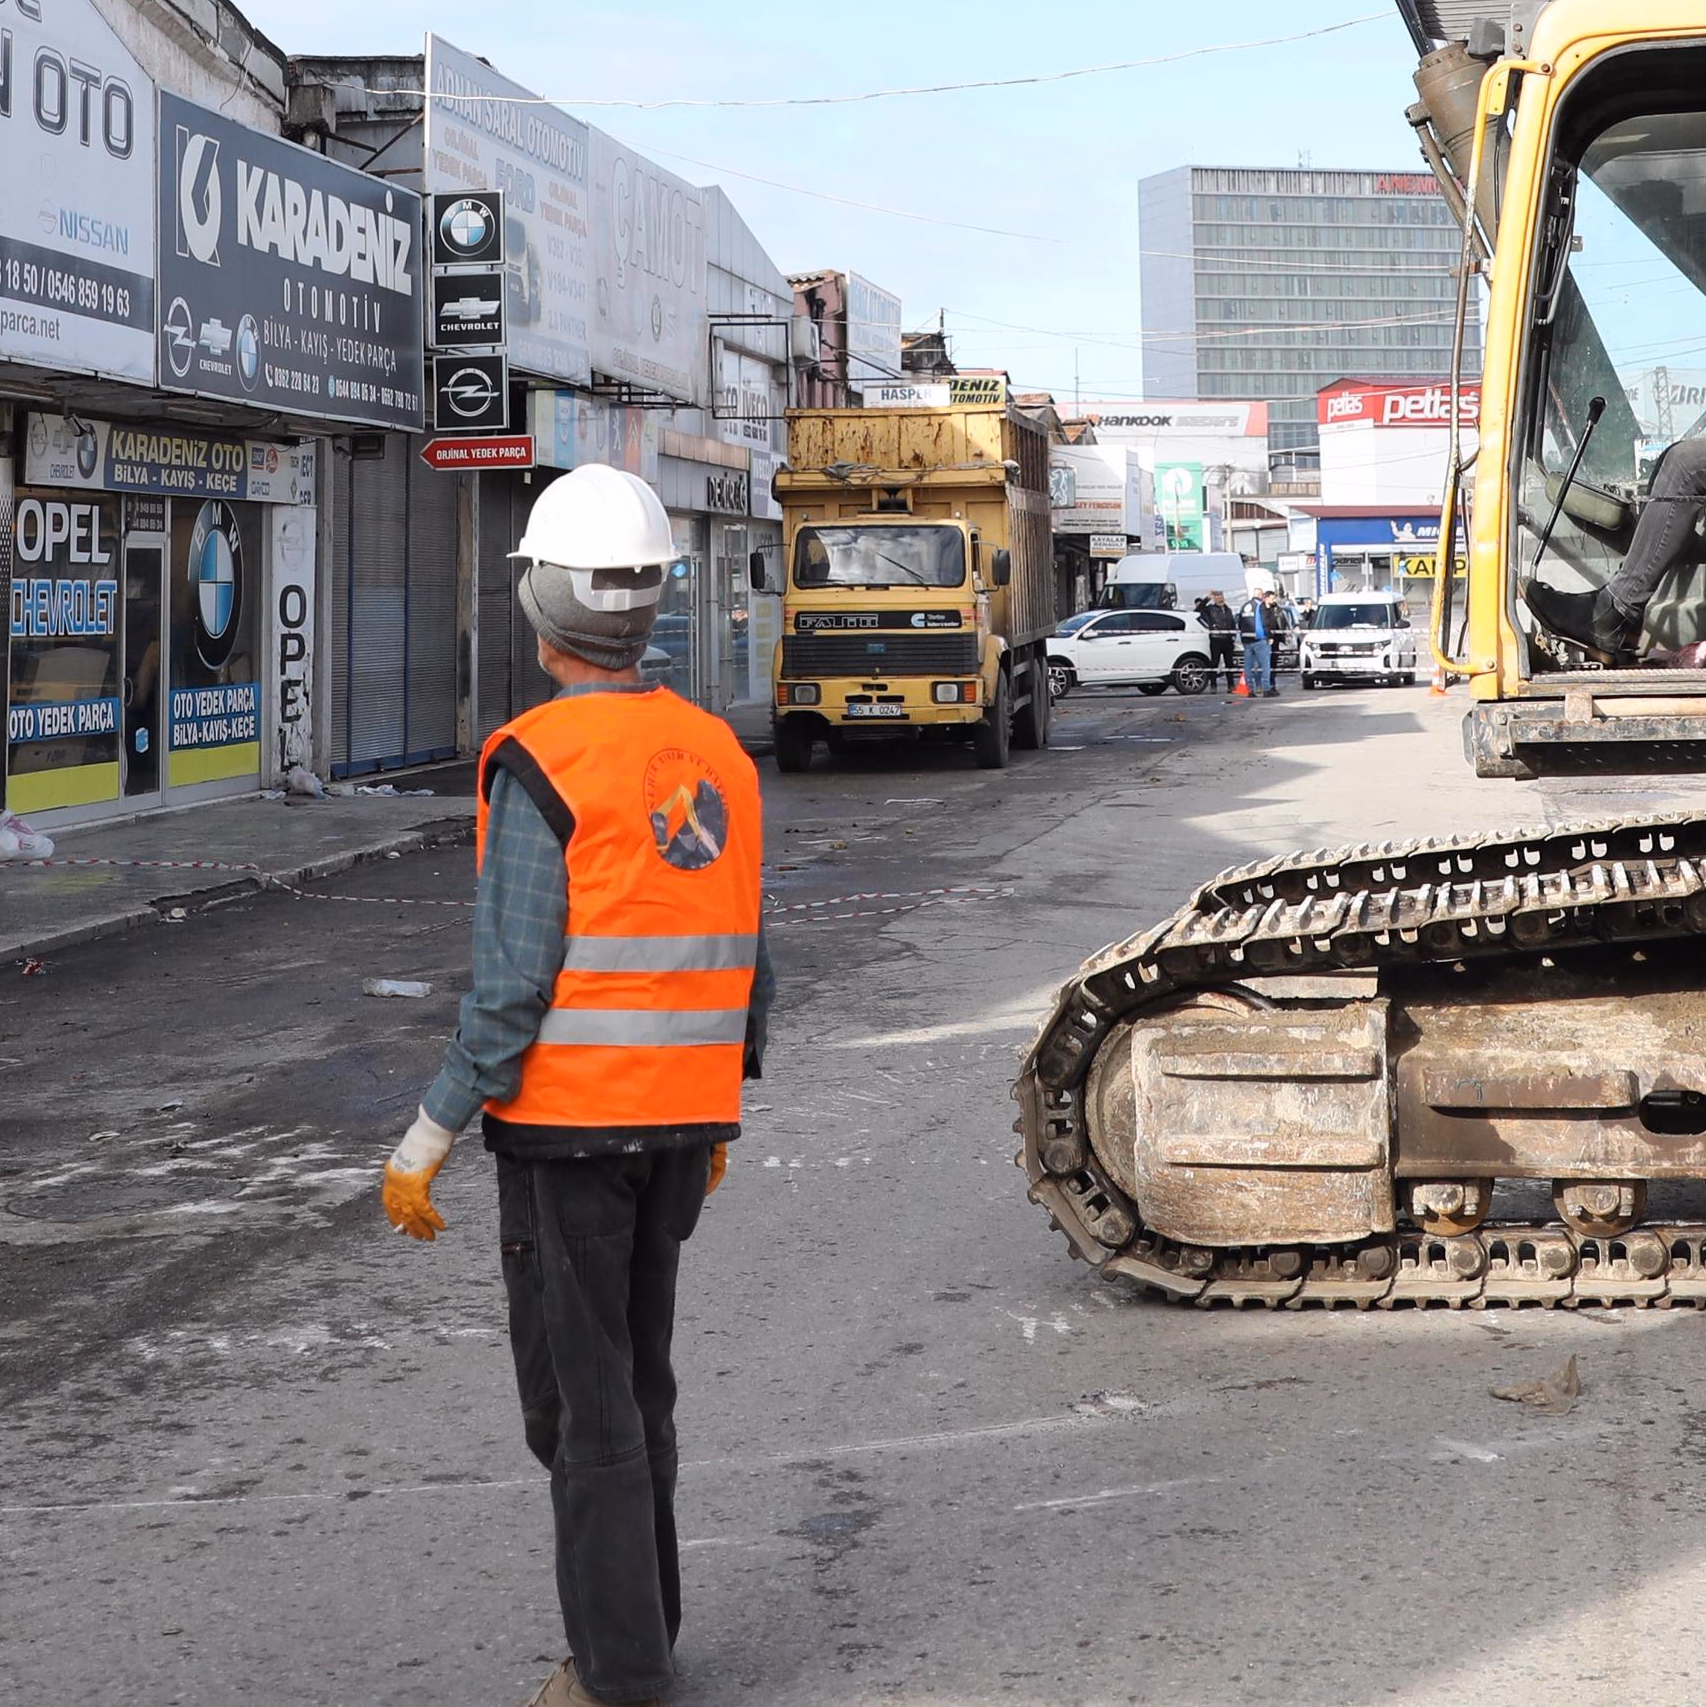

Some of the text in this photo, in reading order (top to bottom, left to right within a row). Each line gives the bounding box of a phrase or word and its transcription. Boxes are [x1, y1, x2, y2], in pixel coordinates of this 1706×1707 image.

[33, 45, 135, 161] OTO
[435, 62, 483, 129] ADNAN
[484, 90, 524, 150] SARAL
[448, 201, 490, 219] BMW
[495, 158, 536, 215] FORD
[59, 208, 129, 256] NISSAN
[237, 159, 412, 296] KARADENİZ
[5, 259, 20, 292] 18
[23, 264, 38, 296] 50
[48, 269, 75, 306] 0546
[78, 277, 99, 311] 859
[101, 283, 114, 315] 19
[117, 288, 131, 319] 63
[283, 278, 381, 334] OTOMOTİV
[263, 315, 398, 378] BİLYA KAYIŞ YEDEK PARÇA
[441, 322, 500, 332] CHEVROLET
[199, 359, 232, 376] CHEVROLET
[1327, 392, 1364, 422] petlas
[211, 444, 243, 473] OTO
[471, 448, 498, 459] YEDEK
[499, 446, 526, 460] PARÇA
[161, 468, 195, 491] KAYIŞ
[206, 475, 237, 493] KEÇE
[16, 498, 111, 564] OPEL
[194, 501, 240, 553] BMW
[10, 578, 117, 637] CHEVROLET
[9, 701, 114, 740] OTO YEDEK PARÇA
[173, 686, 256, 720] OTO YEDEK PARÇA
[853, 705, 900, 715] 55 K 0247
